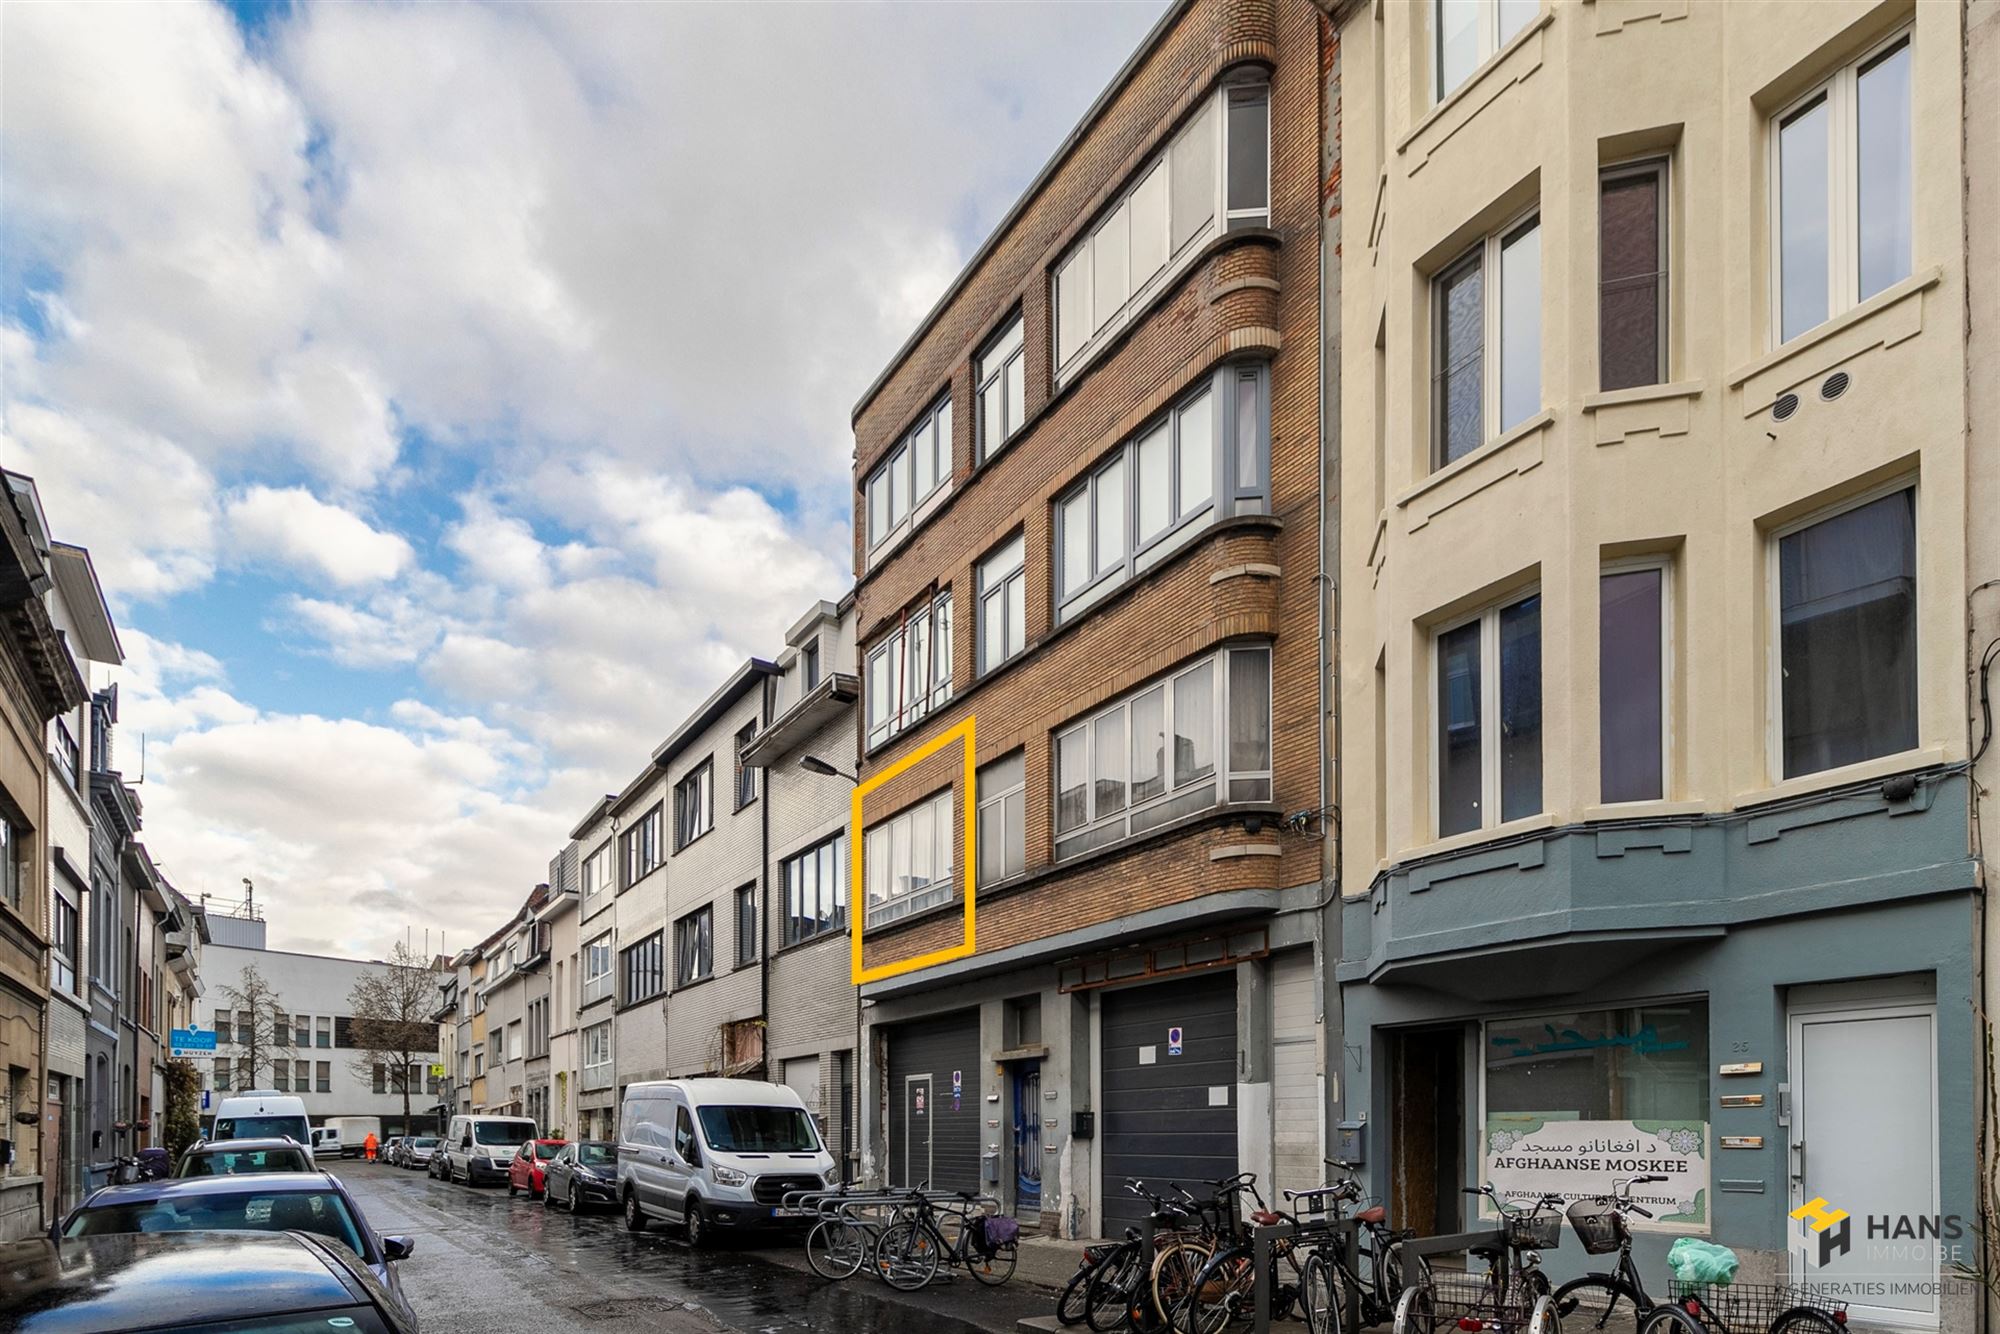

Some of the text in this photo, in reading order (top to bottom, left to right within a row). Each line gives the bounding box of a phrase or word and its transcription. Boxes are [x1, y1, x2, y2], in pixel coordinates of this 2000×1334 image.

[1732, 1041, 1749, 1053] 25
[1522, 1142, 1573, 1155] مسجد
[1494, 1157, 1688, 1174] AFGHAANSE MOSKEE
[1624, 1195, 1677, 1206] ENTRUM
